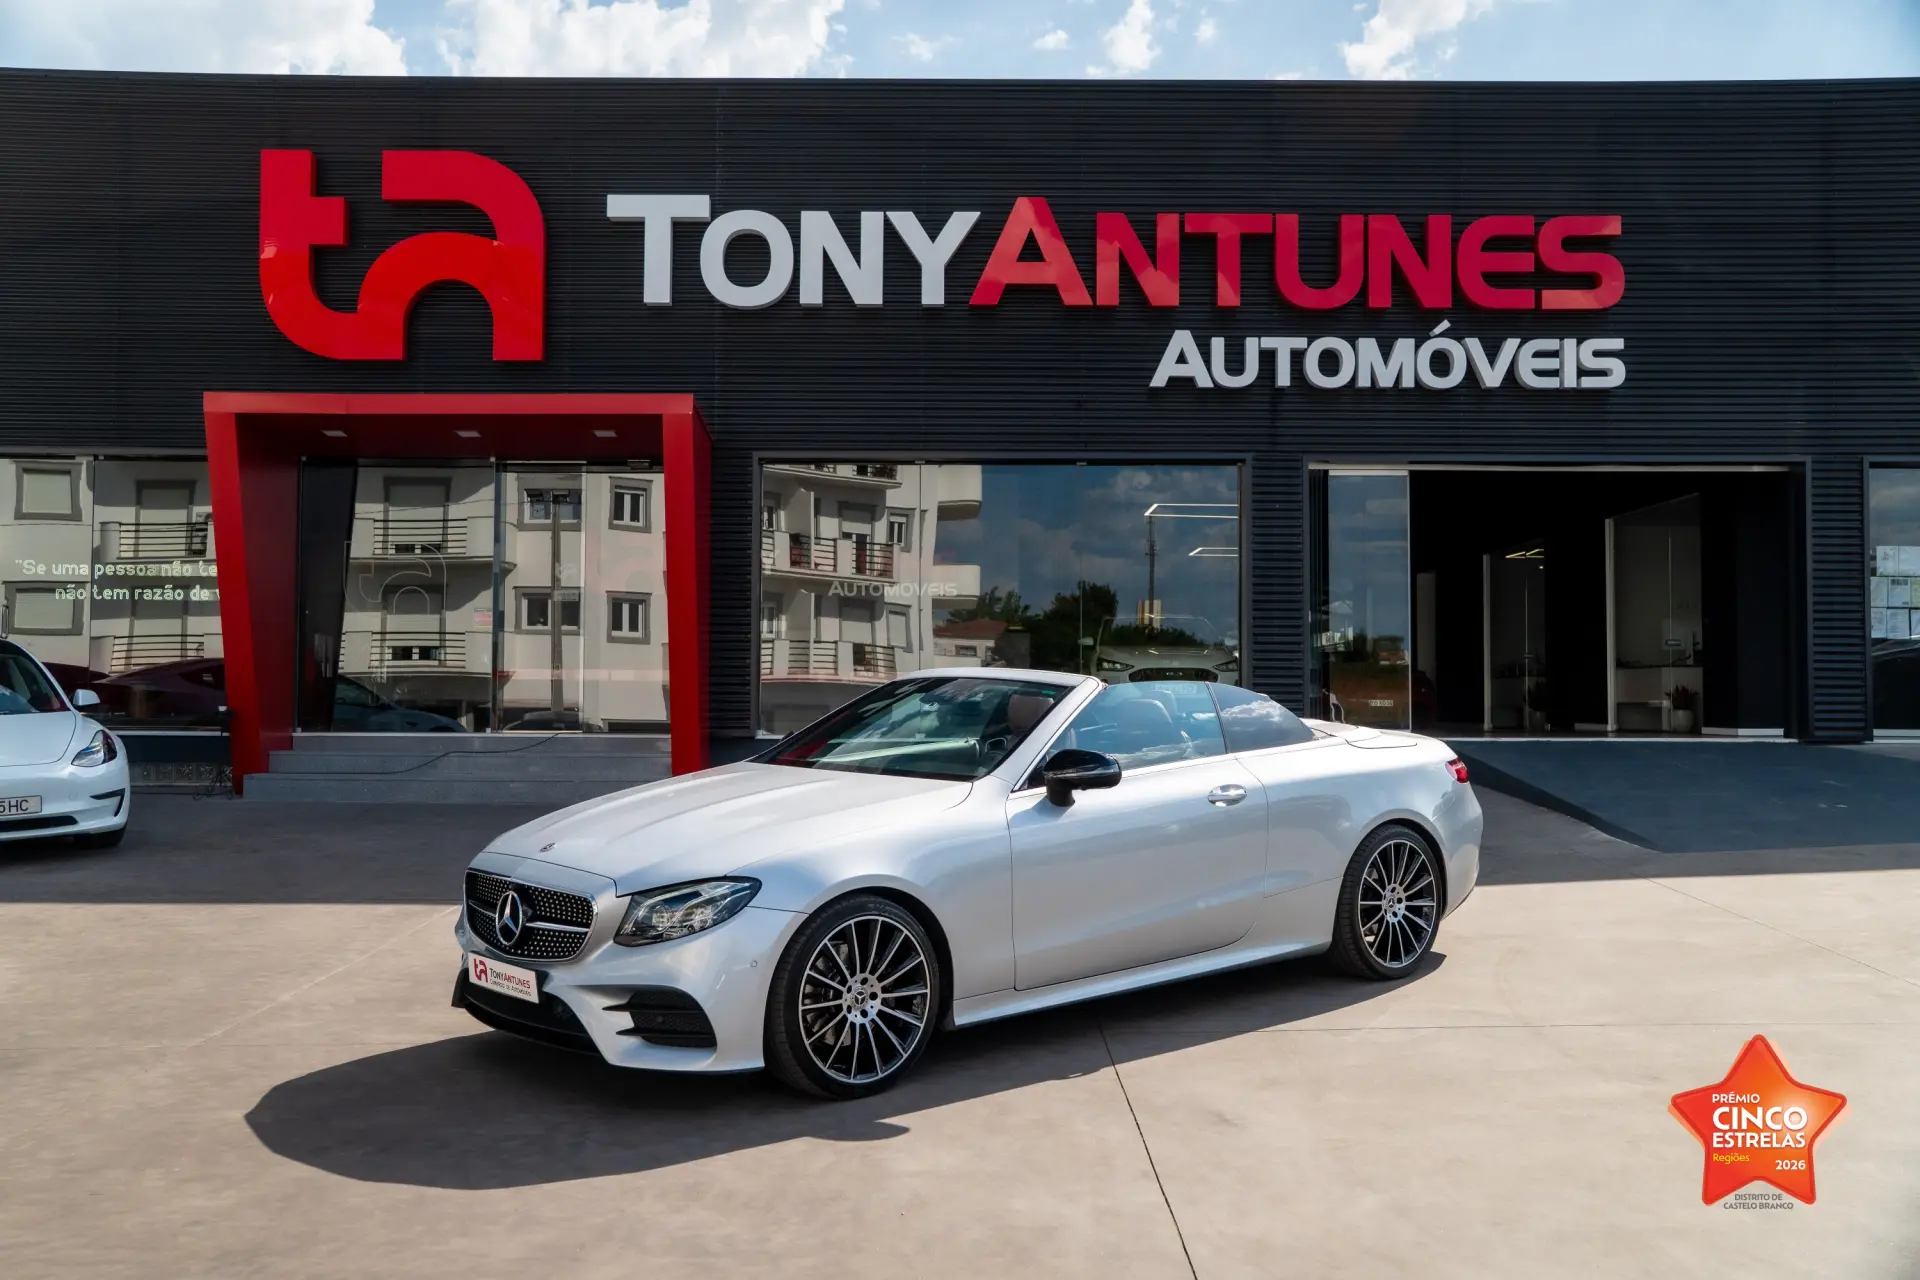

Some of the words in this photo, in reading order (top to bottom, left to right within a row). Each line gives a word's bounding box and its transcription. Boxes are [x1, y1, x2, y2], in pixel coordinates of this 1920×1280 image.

[1148, 319, 1627, 391] AUTOMÓVEIS
[52, 562, 89, 576] uma
[94, 563, 157, 579] pessoa
[161, 560, 192, 577] não
[55, 584, 87, 600] não
[92, 585, 129, 600] tem
[134, 584, 184, 600] razão
[189, 585, 210, 600] de
